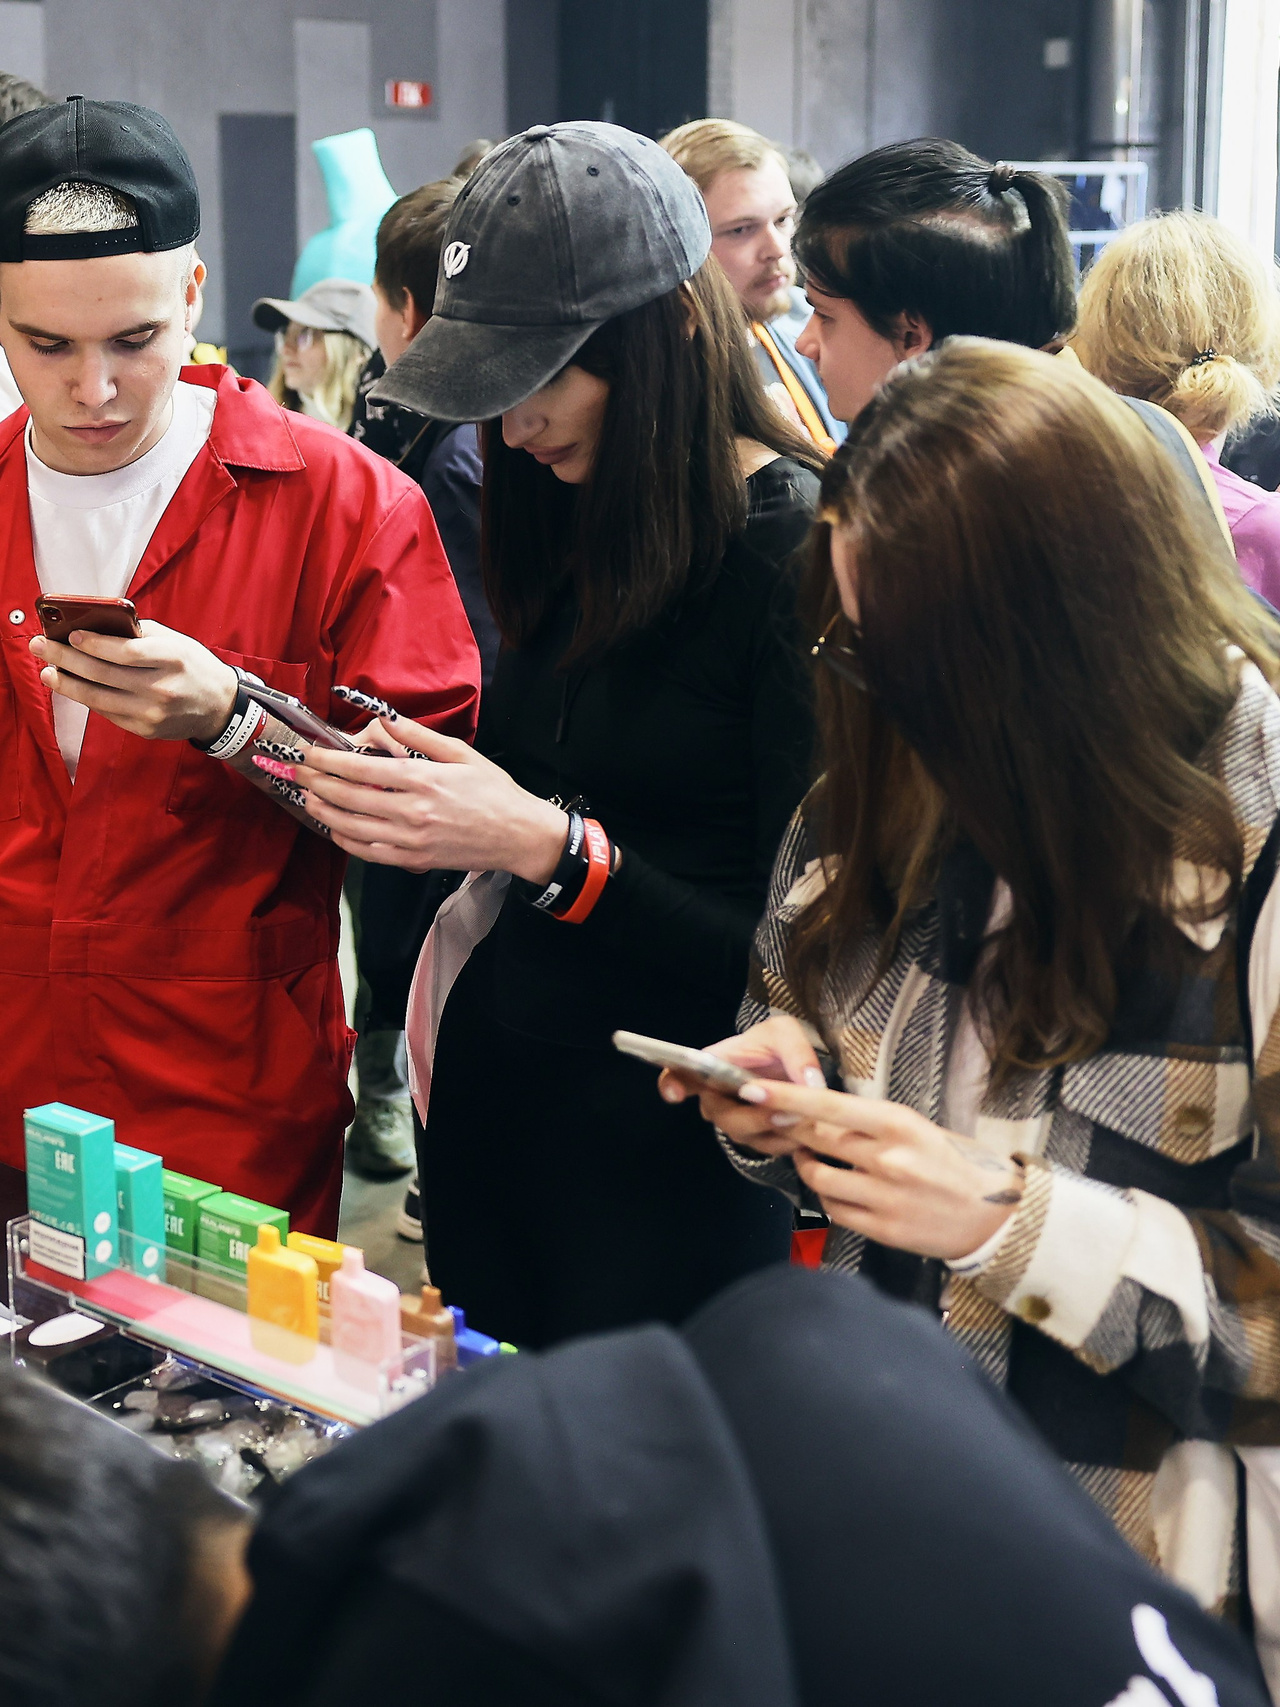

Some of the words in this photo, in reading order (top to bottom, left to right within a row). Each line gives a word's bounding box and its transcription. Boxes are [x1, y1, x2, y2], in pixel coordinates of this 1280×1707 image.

[219, 725, 236, 745] F374
[569, 829, 582, 856] MAIN
[584, 821, 607, 865] IPLAY
